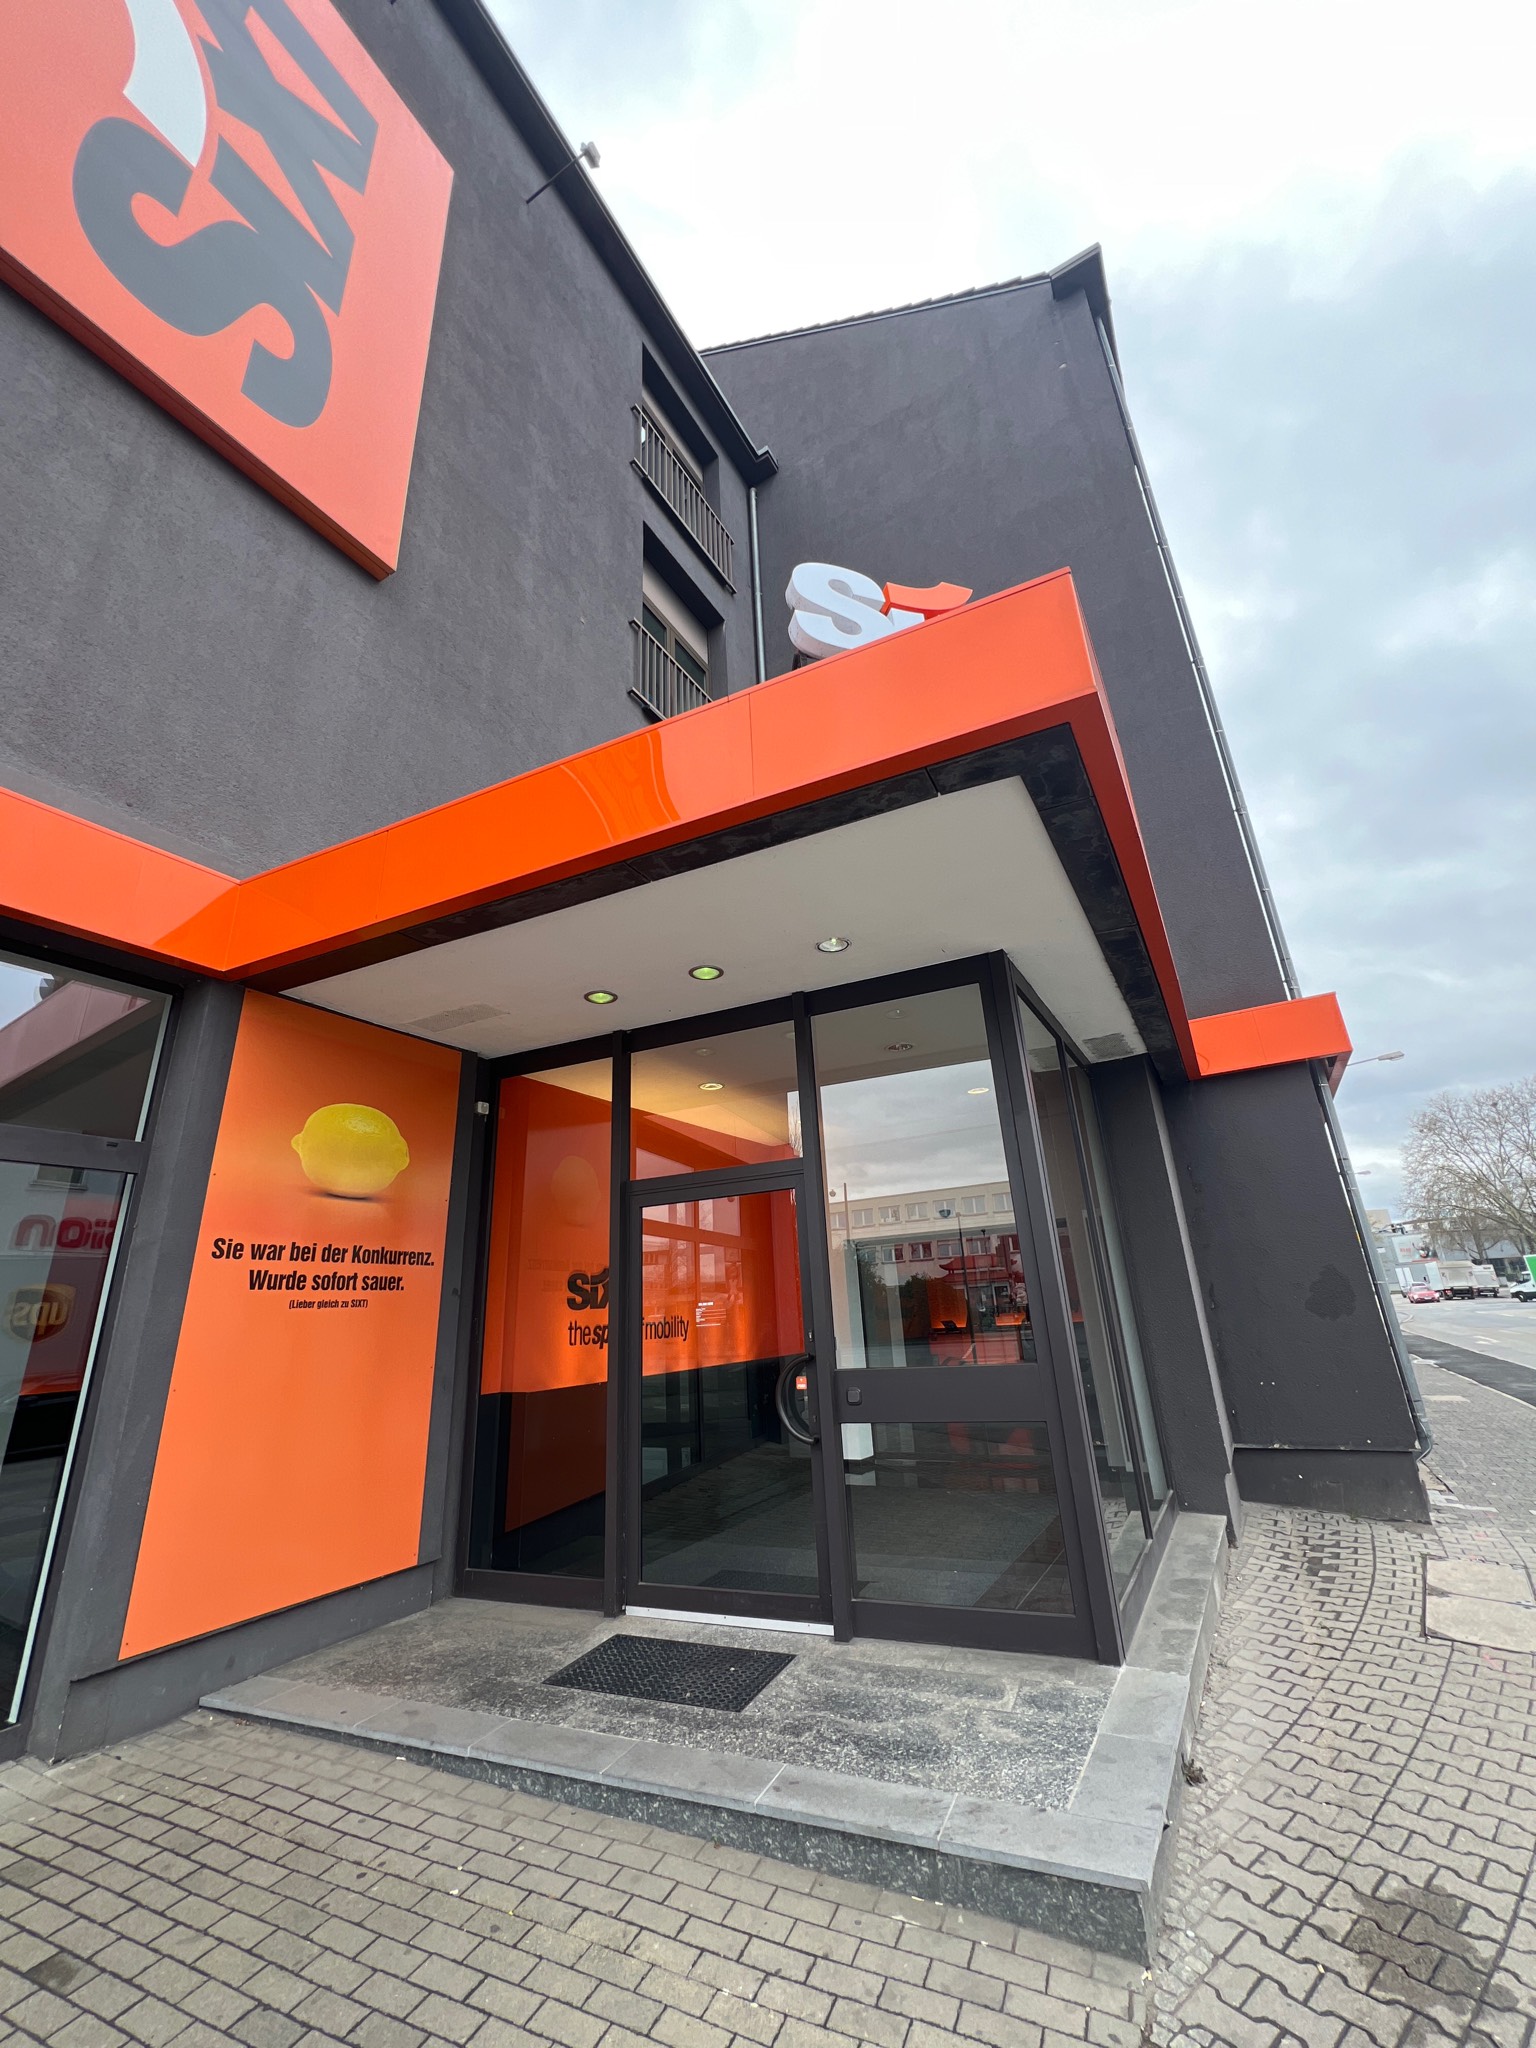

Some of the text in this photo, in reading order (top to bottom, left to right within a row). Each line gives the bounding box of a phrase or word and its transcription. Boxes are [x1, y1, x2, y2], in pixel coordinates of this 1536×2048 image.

[211, 1237, 435, 1267] Sie war bei der Konkurrenz.
[249, 1269, 405, 1292] Wurde sofort sauer.
[288, 1298, 369, 1310] (Lieber gleich zu SIXT)
[644, 1315, 690, 1342] mobility
